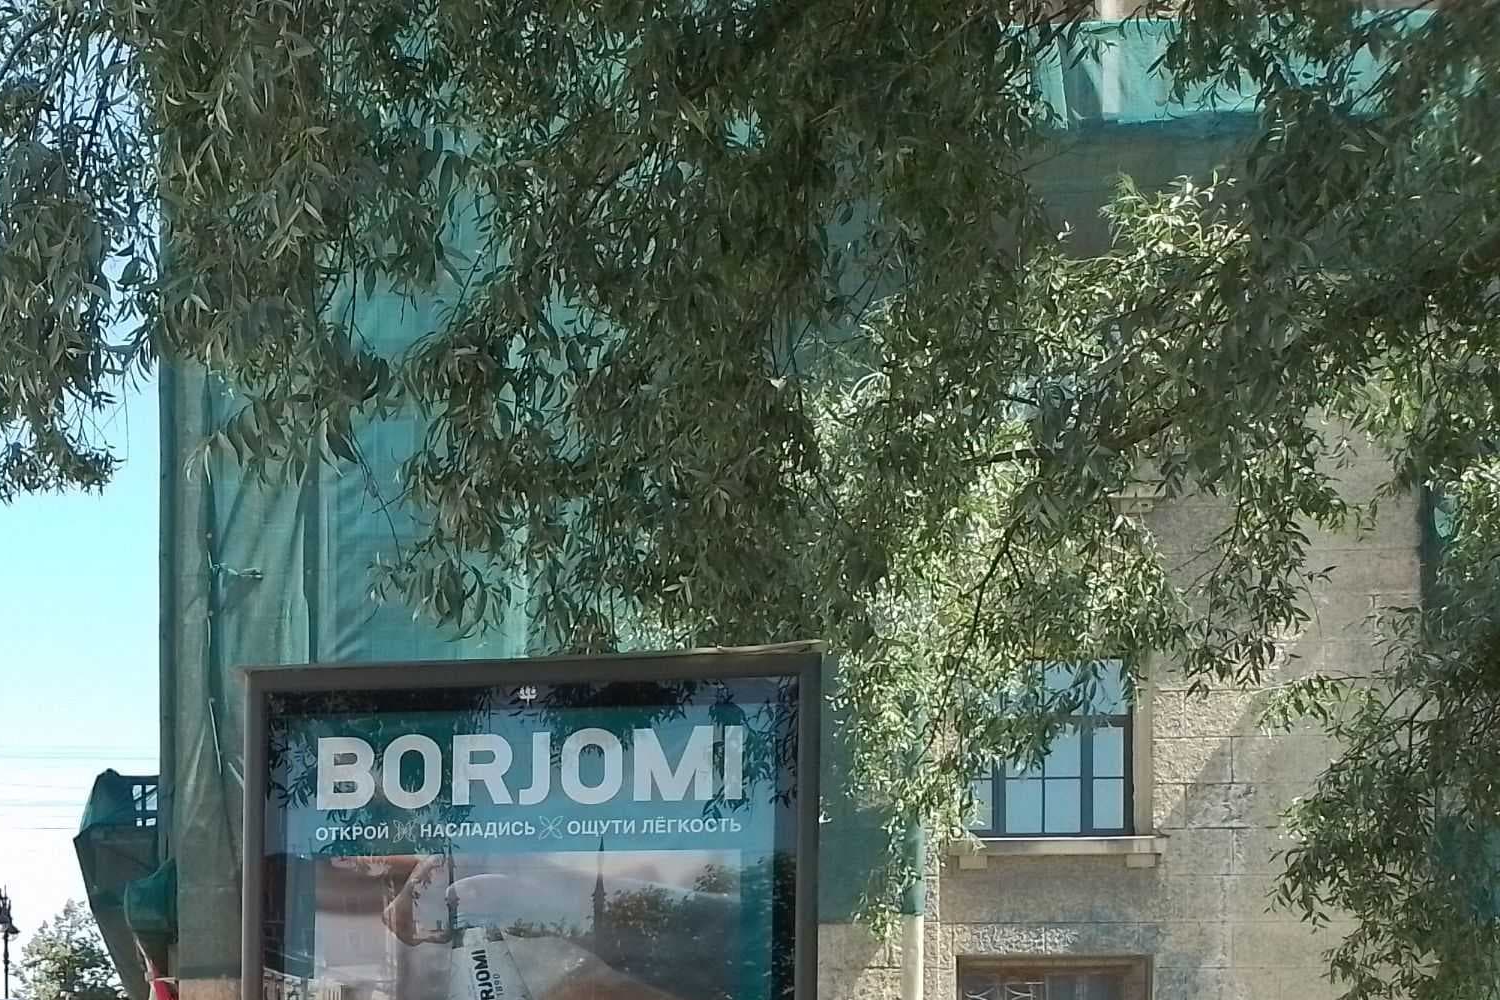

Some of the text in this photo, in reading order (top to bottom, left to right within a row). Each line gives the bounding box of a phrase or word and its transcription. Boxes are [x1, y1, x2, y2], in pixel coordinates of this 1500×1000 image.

[315, 725, 744, 812] BORJOMI
[315, 816, 743, 841] ОТКРОЙ НАСЛАДИСЬ ОЩУТИ ЛЁГКОСТЬ
